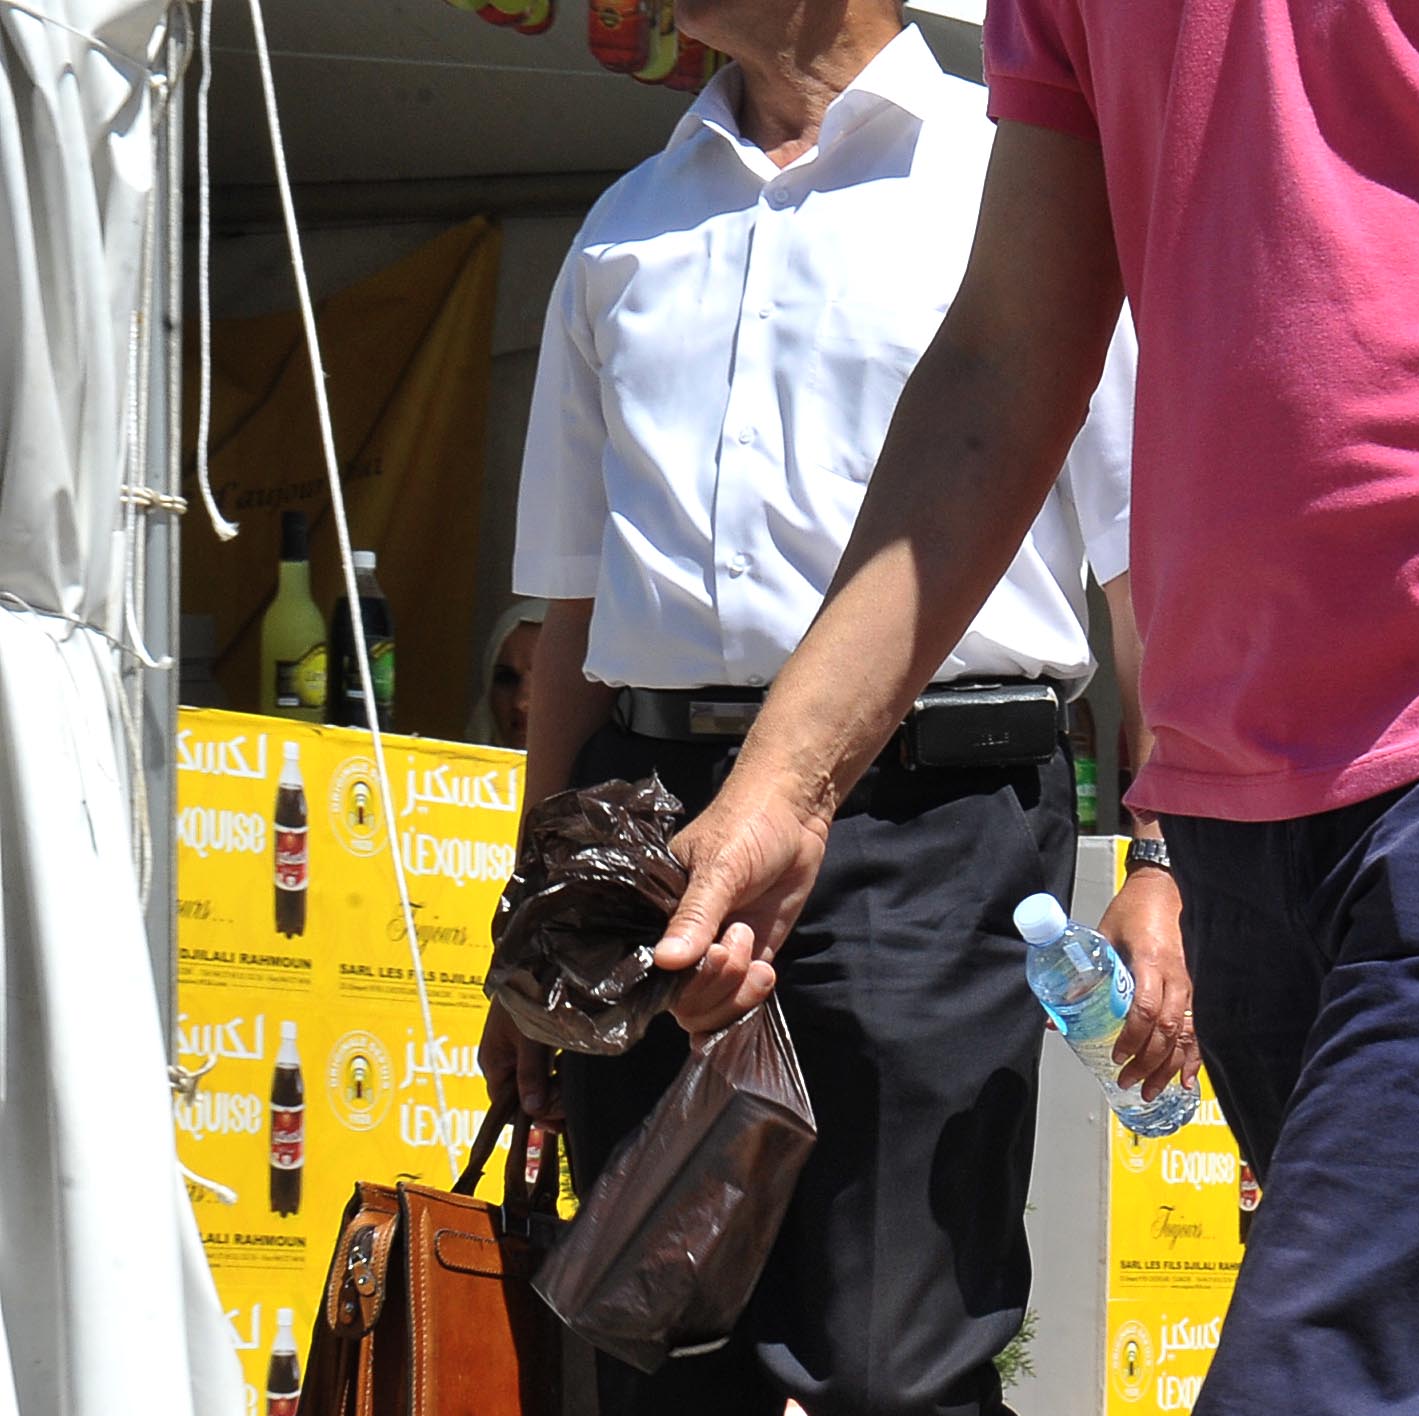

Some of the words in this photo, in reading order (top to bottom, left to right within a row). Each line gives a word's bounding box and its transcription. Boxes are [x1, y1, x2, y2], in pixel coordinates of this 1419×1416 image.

[340, 963, 374, 977] SARL
[379, 966, 404, 980] LES
[1120, 1260, 1142, 1270] SARL
[1144, 1260, 1161, 1270] LES
